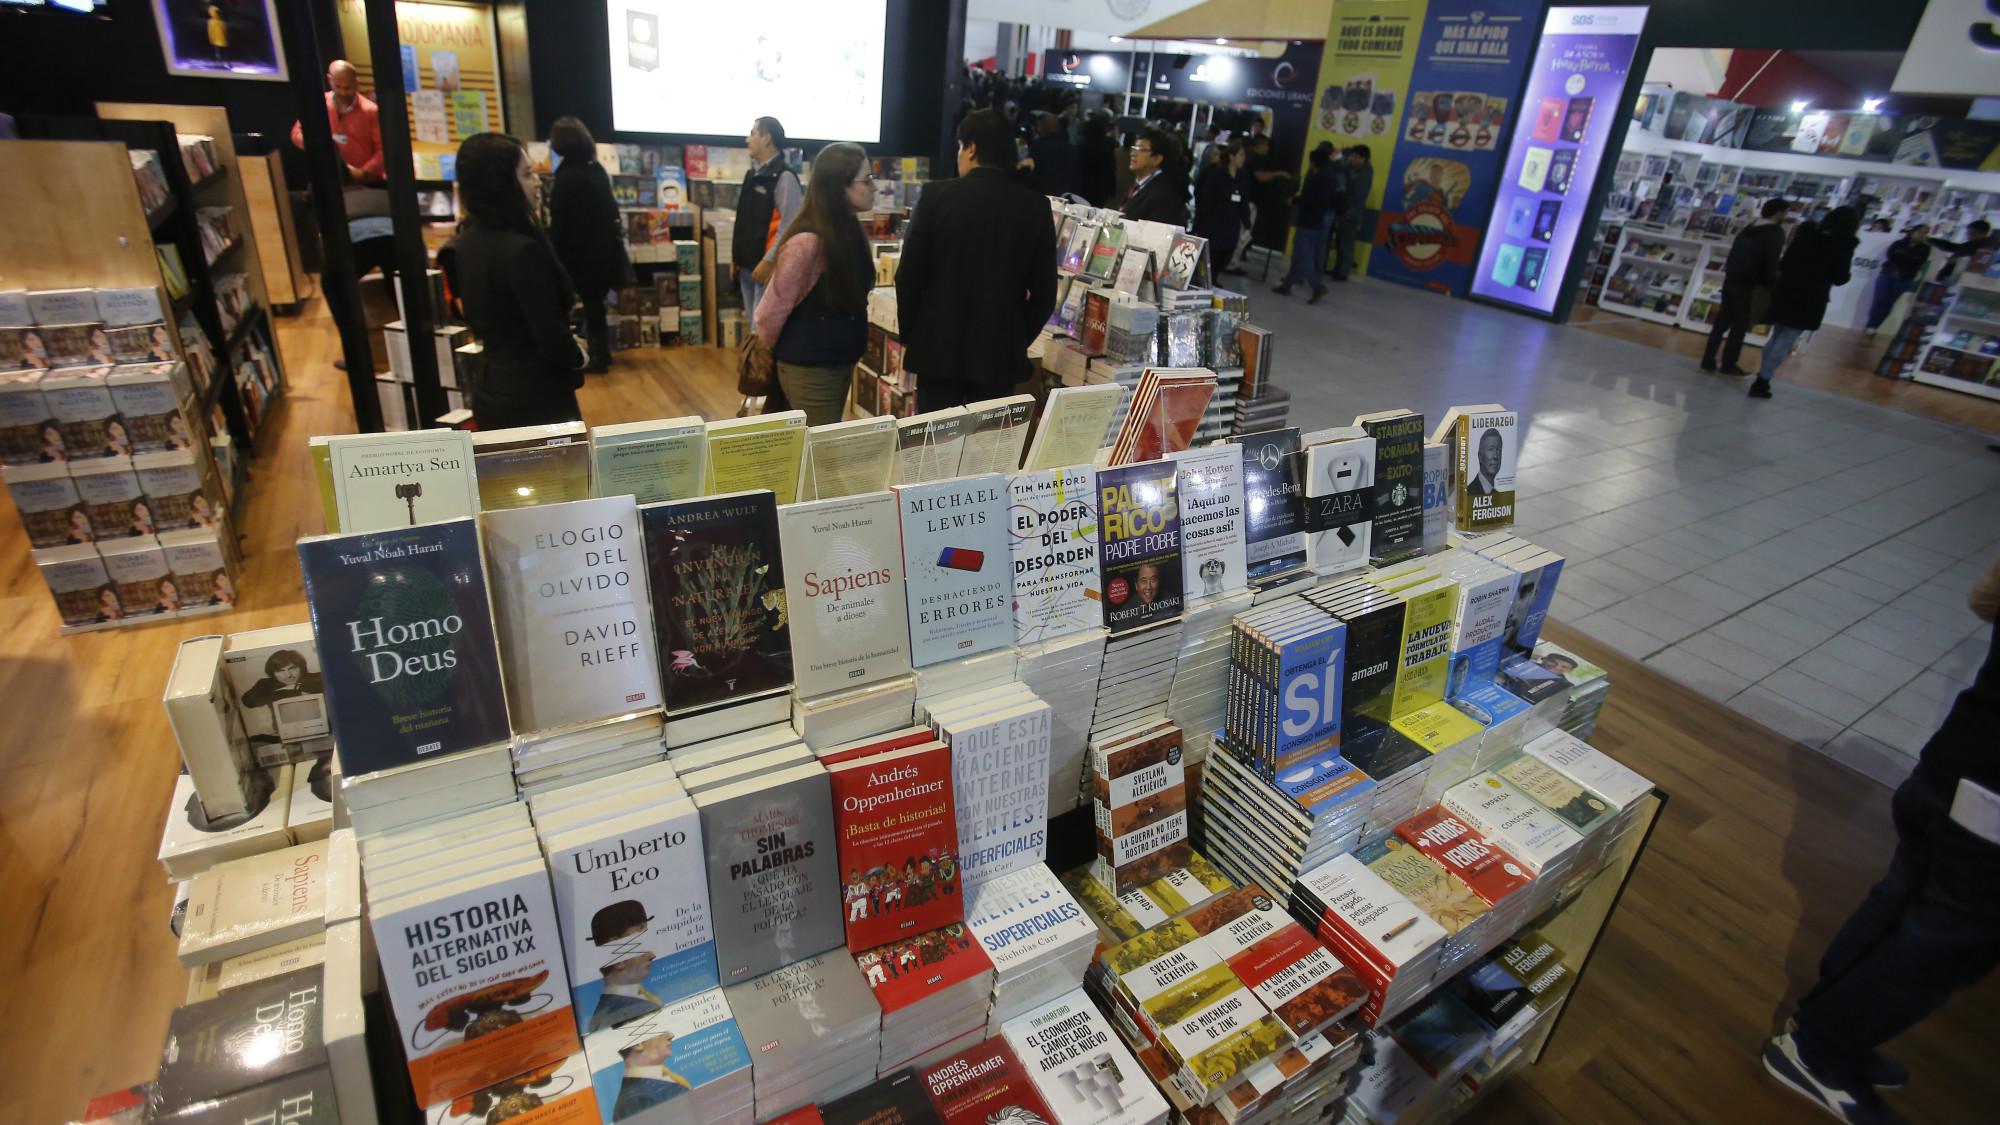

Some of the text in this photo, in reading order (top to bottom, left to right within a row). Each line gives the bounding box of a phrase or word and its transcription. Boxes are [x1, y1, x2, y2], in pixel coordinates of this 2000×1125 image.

[1376, 420, 1422, 438] STARBUCKS
[1472, 416, 1514, 428] LIDERAZGO
[349, 457, 461, 479] Amartya Sen
[1014, 475, 1087, 494] TIM HARFORD
[911, 488, 999, 514] MICHAEL
[1188, 494, 1230, 510] ¡Aquí no
[1225, 506, 1240, 517] las
[1320, 493, 1364, 516] ZARA
[1472, 496, 1493, 508] ALEX
[1472, 505, 1512, 520] FERGUSON
[667, 505, 759, 526] ANDREA WULF
[812, 518, 872, 534] Yuval Noah Harari
[928, 512, 986, 533] LEWIS
[1018, 506, 1088, 530] EL PODER
[1104, 507, 1166, 542] RICO
[536, 524, 623, 550] ELOGIO
[1041, 531, 1068, 546] DEL
[1186, 520, 1234, 540] cosas así!
[340, 550, 372, 566] Yuval
[374, 546, 405, 562] Noah
[407, 541, 444, 556] Harari
[586, 548, 628, 566] DEL
[1105, 538, 1142, 560] PADRE
[1145, 530, 1178, 553] POBRE
[1016, 546, 1094, 574] DESORDEN
[540, 571, 630, 598] OLVIDO
[804, 568, 891, 601] Sapiens
[1017, 567, 1094, 588] PARA TRANSFORMAR
[1030, 580, 1084, 598] NUESTRA VIDA
[826, 598, 874, 613] De animales
[922, 582, 1002, 606] DESHACIENDO
[843, 611, 866, 622] dioses
[920, 595, 1005, 624] ERRORES
[1110, 597, 1180, 622] ROBERT T. KIYOSAKI
[346, 615, 462, 652] Homo
[565, 620, 636, 646] DAVID
[366, 650, 456, 684] Deus
[581, 643, 640, 667] RIEFF
[1284, 658, 1328, 678] OBTENGA EL
[1352, 660, 1388, 682] amazon
[1282, 648, 1342, 737] SÍ
[1008, 712, 1048, 746] ESTÁ
[1282, 724, 1338, 752] CONSIGO MISMO
[956, 736, 1048, 782] HACIENDO
[1548, 742, 1592, 766] blink
[867, 764, 918, 788] Andrés
[956, 758, 1048, 804] INTERNET
[1132, 778, 1168, 798] ALEXIÉVICH
[1134, 766, 1165, 786] SVETLANA
[843, 779, 944, 814] Oppenheimer
[956, 782, 1046, 822] CON NUESTRAS
[1482, 792, 1512, 810] EMPRESA
[846, 802, 946, 840] ¡Basta de historias!
[958, 802, 1046, 846] MENTES?
[1501, 806, 1542, 830] CONSCIENTE
[757, 832, 786, 854] SIN
[1120, 816, 1182, 850] LA GUERRA NO TIENE
[1421, 817, 1469, 846] VENDES
[572, 831, 686, 874] Umberto
[1124, 829, 1180, 860] ROSTRO DE MUJER
[1442, 838, 1490, 868] VENDES
[730, 842, 815, 881] PALABRAS
[782, 866, 798, 878] HA
[288, 854, 318, 914] Sapiens
[608, 866, 660, 893] Eco
[744, 873, 810, 902] PASADO CON
[1310, 874, 1330, 887] Daniel
[1316, 874, 1346, 892] Kahneman
[741, 883, 814, 914] EL LENGUAJE
[1330, 888, 1356, 905] Pensar
[1340, 894, 1366, 912] rápido,
[404, 894, 528, 949] HISTORIA
[676, 902, 702, 918] De la
[753, 906, 808, 934] POLÍTICA?
[764, 902, 794, 918] DE LA
[1348, 903, 1374, 922] pensar
[1358, 905, 1389, 927] despacio
[656, 914, 704, 936] estupidez
[686, 926, 704, 938] a la
[412, 918, 532, 970] ALTERNATIVA
[675, 936, 706, 952] locura
[415, 936, 536, 988] DEL SIGLO XX
[1150, 952, 1188, 976] SVETLANA
[1504, 945, 1528, 968] ALEX
[1514, 942, 1556, 975] FERGUSON
[1156, 962, 1198, 988] ALEXIÉVICH
[286, 985, 318, 1056] Homo
[1030, 1005, 1071, 1028] TIM HARFORD
[1182, 998, 1242, 1036] LOS MUCHACHOS
[1026, 1010, 1092, 1048] EL ECONOMISTA
[1040, 1024, 1092, 1056] CAMUFLADO
[1206, 1018, 1238, 1040] DE ZINC
[1039, 1032, 1109, 1072] ATACA DE NUEVO
[928, 1058, 969, 1086] ANDRÉS
[932, 1055, 1006, 1096] OPPENHEIMER
